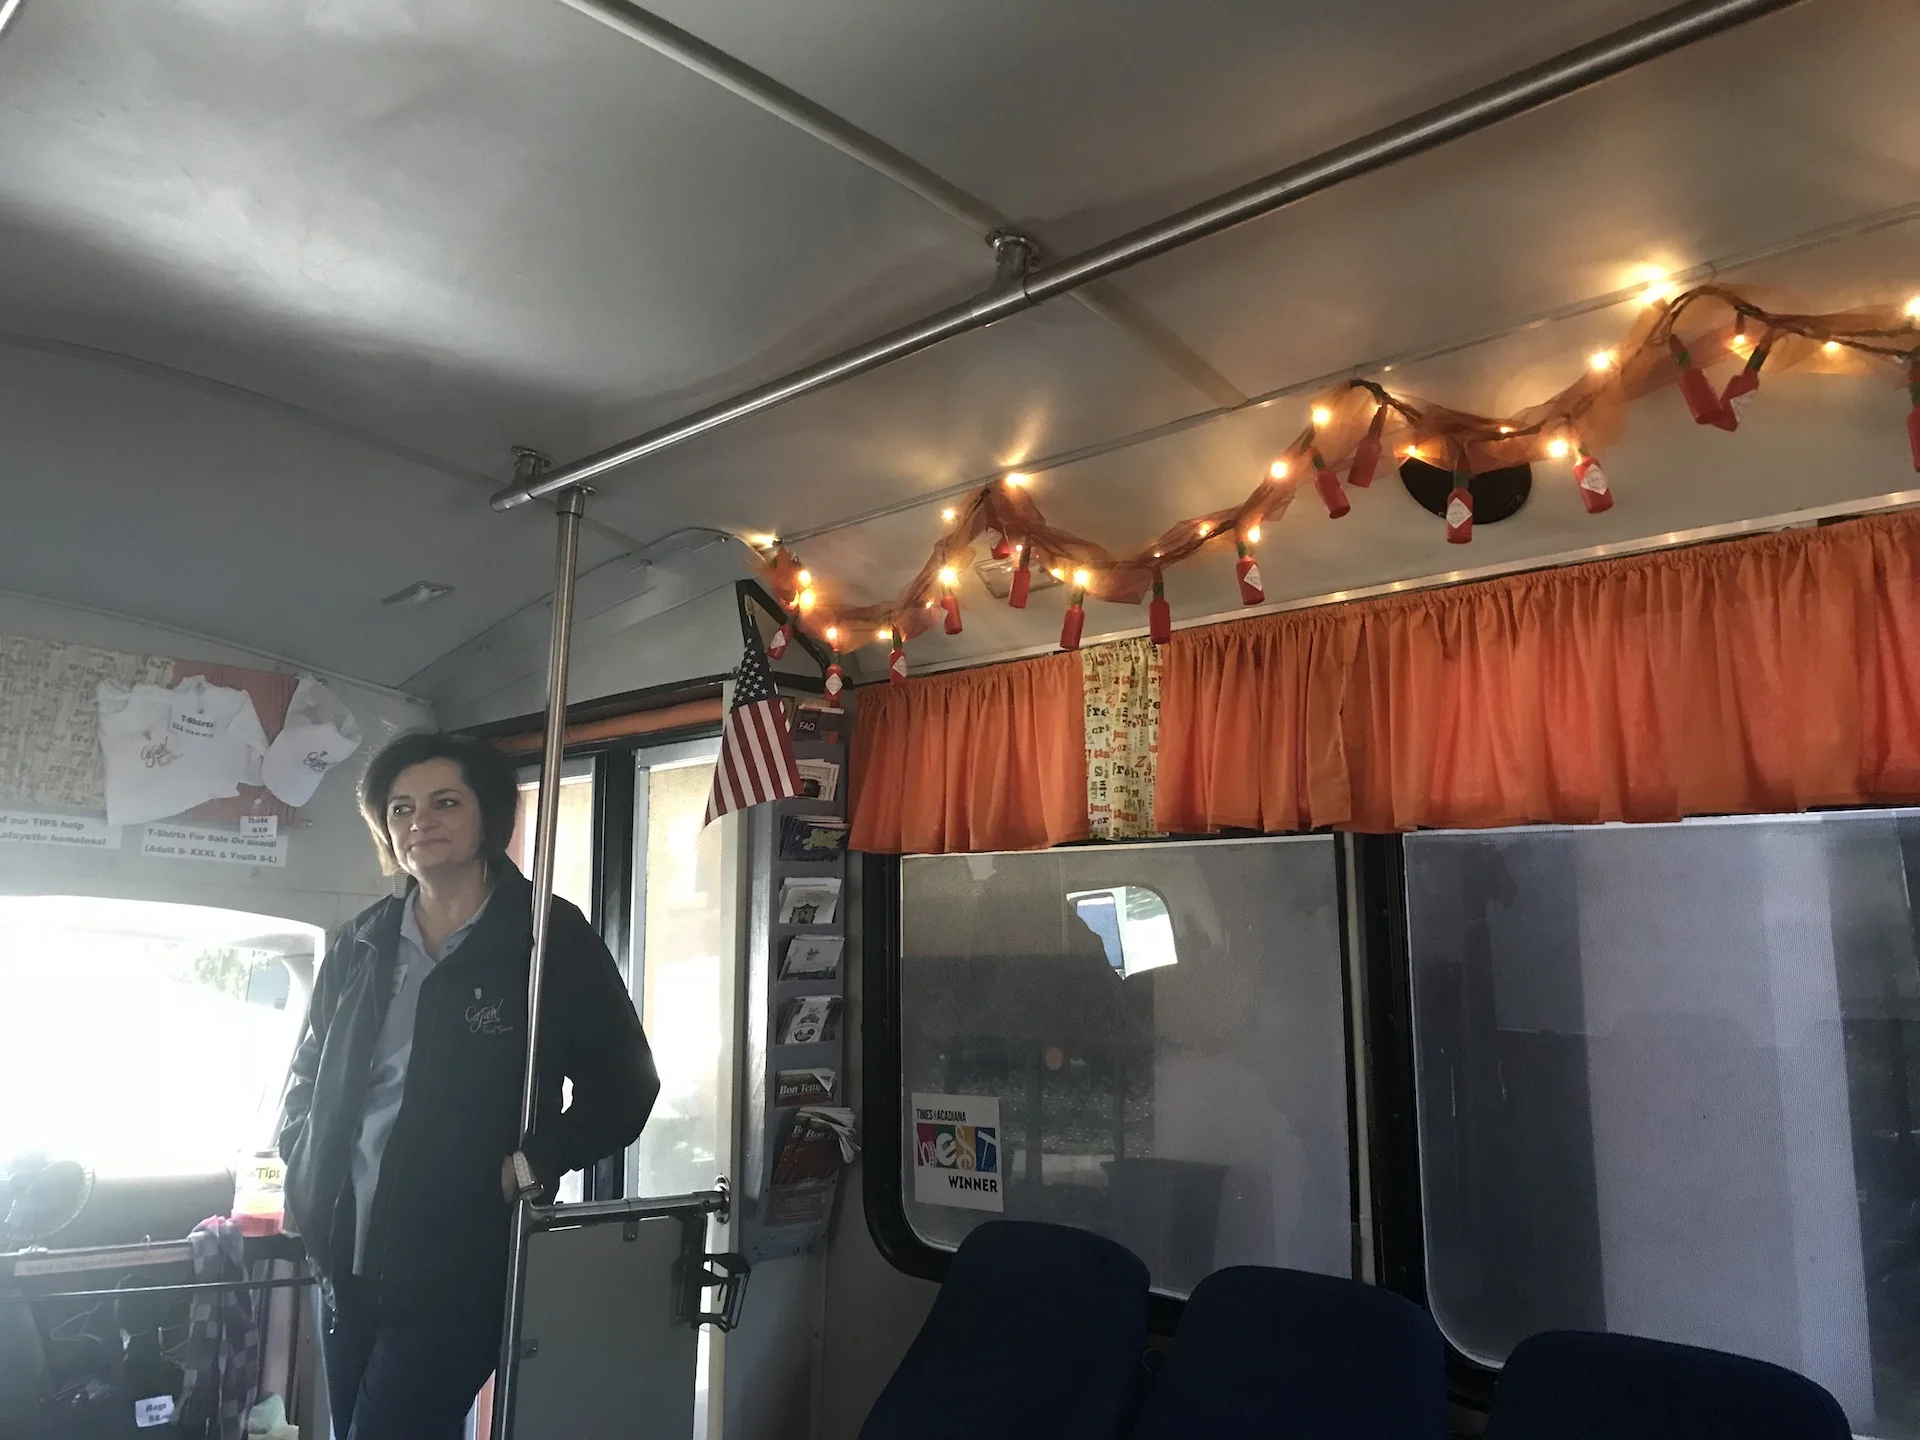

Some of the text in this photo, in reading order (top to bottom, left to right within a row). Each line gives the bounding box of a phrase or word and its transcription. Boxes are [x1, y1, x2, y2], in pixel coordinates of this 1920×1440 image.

[798, 721, 816, 732] FAQ
[32, 817, 58, 828] TIPS
[147, 828, 187, 840] T-Shirts
[189, 832, 206, 842] For
[207, 834, 229, 844] Sale
[779, 1085, 798, 1095] Bon
[916, 1108, 933, 1120] TIMES
[937, 1110, 967, 1122] ACADIANA
[256, 1167, 280, 1179] Tips
[948, 1175, 998, 1193] WINNER
